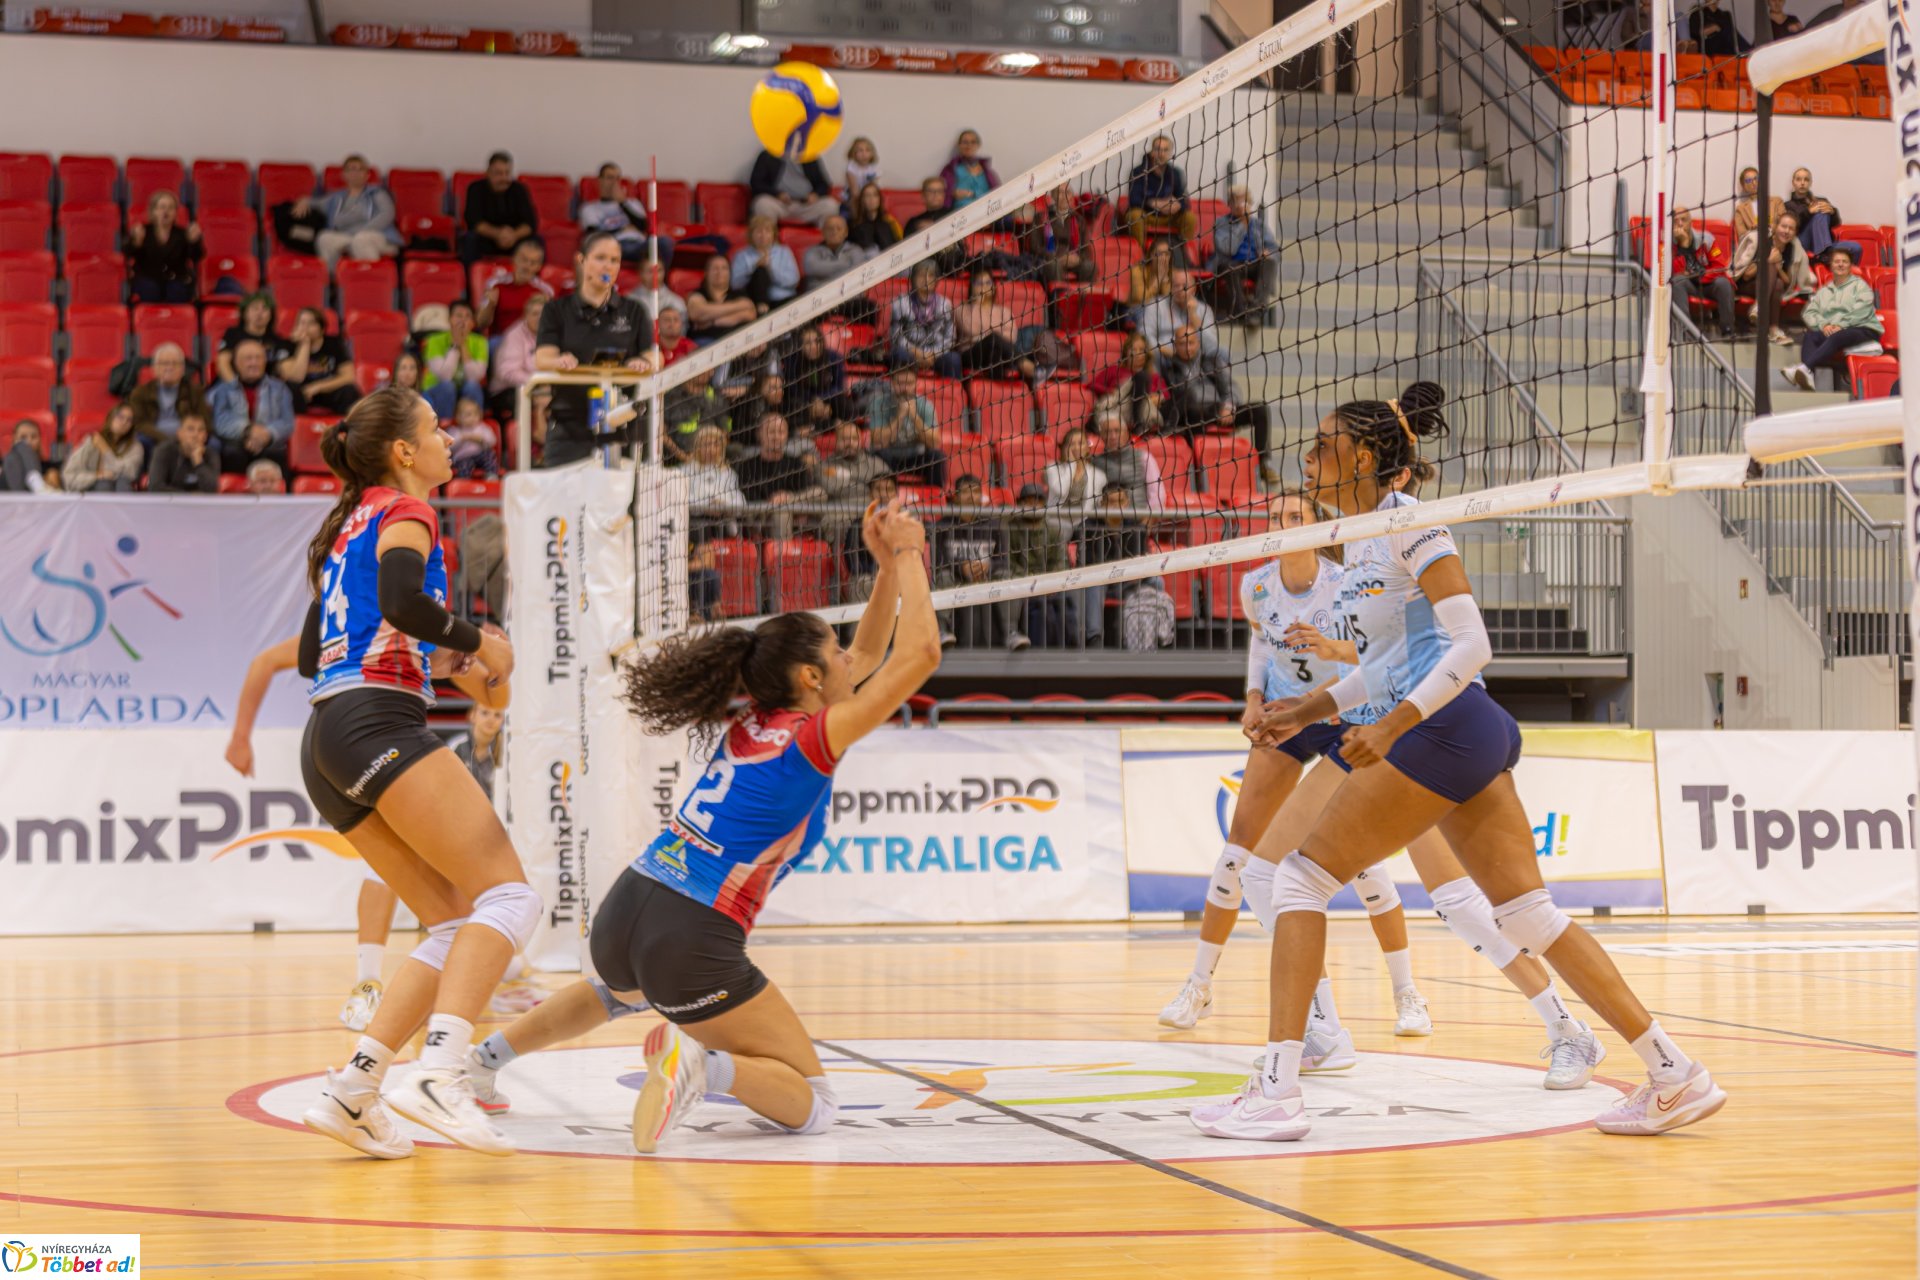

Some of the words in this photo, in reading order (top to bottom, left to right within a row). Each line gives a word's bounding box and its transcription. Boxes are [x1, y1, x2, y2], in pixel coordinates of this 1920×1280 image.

[32, 672, 131, 689] MAGYAR
[1291, 658, 1313, 683] 3
[0, 789, 332, 866] mixPR
[680, 758, 736, 834] 2
[550, 760, 578, 929] TippmixPRO
